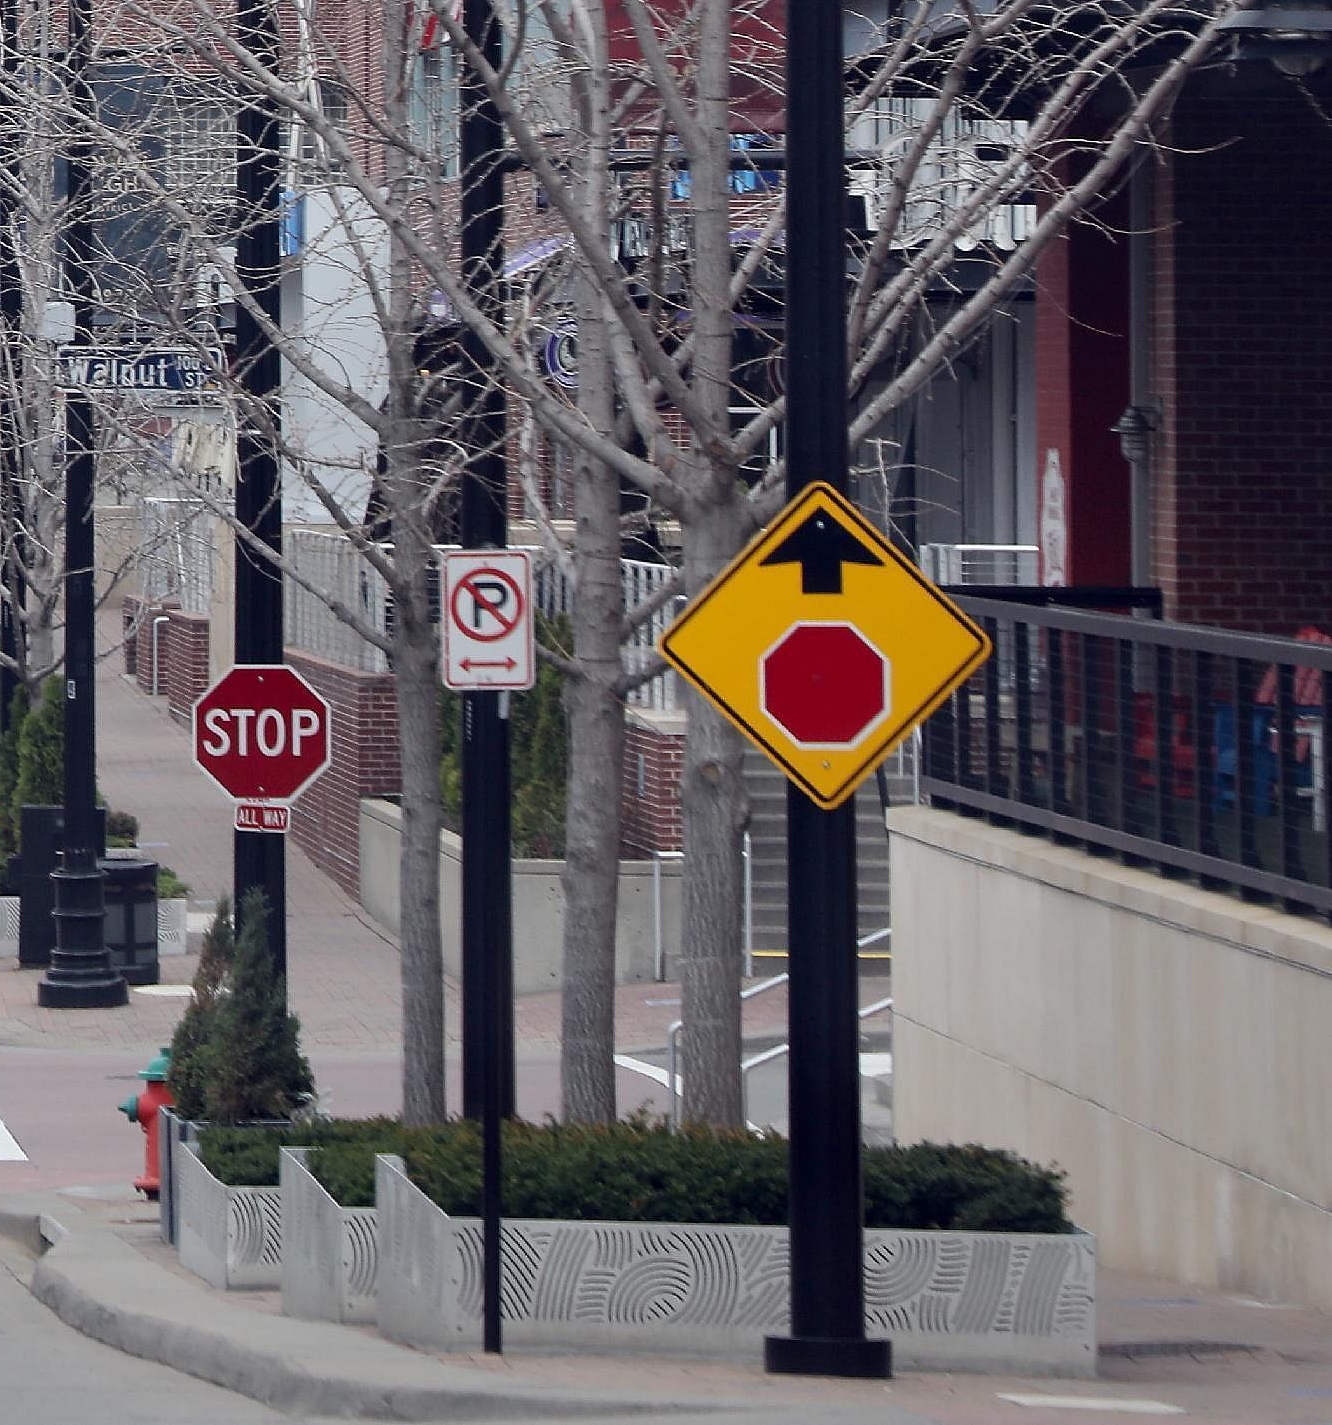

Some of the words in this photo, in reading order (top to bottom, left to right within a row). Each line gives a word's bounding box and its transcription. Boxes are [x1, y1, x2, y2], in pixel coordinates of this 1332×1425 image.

[68, 356, 170, 388] Walnut
[203, 708, 320, 757] STOP
[238, 809, 259, 825] ALL
[263, 810, 286, 826] WAY
